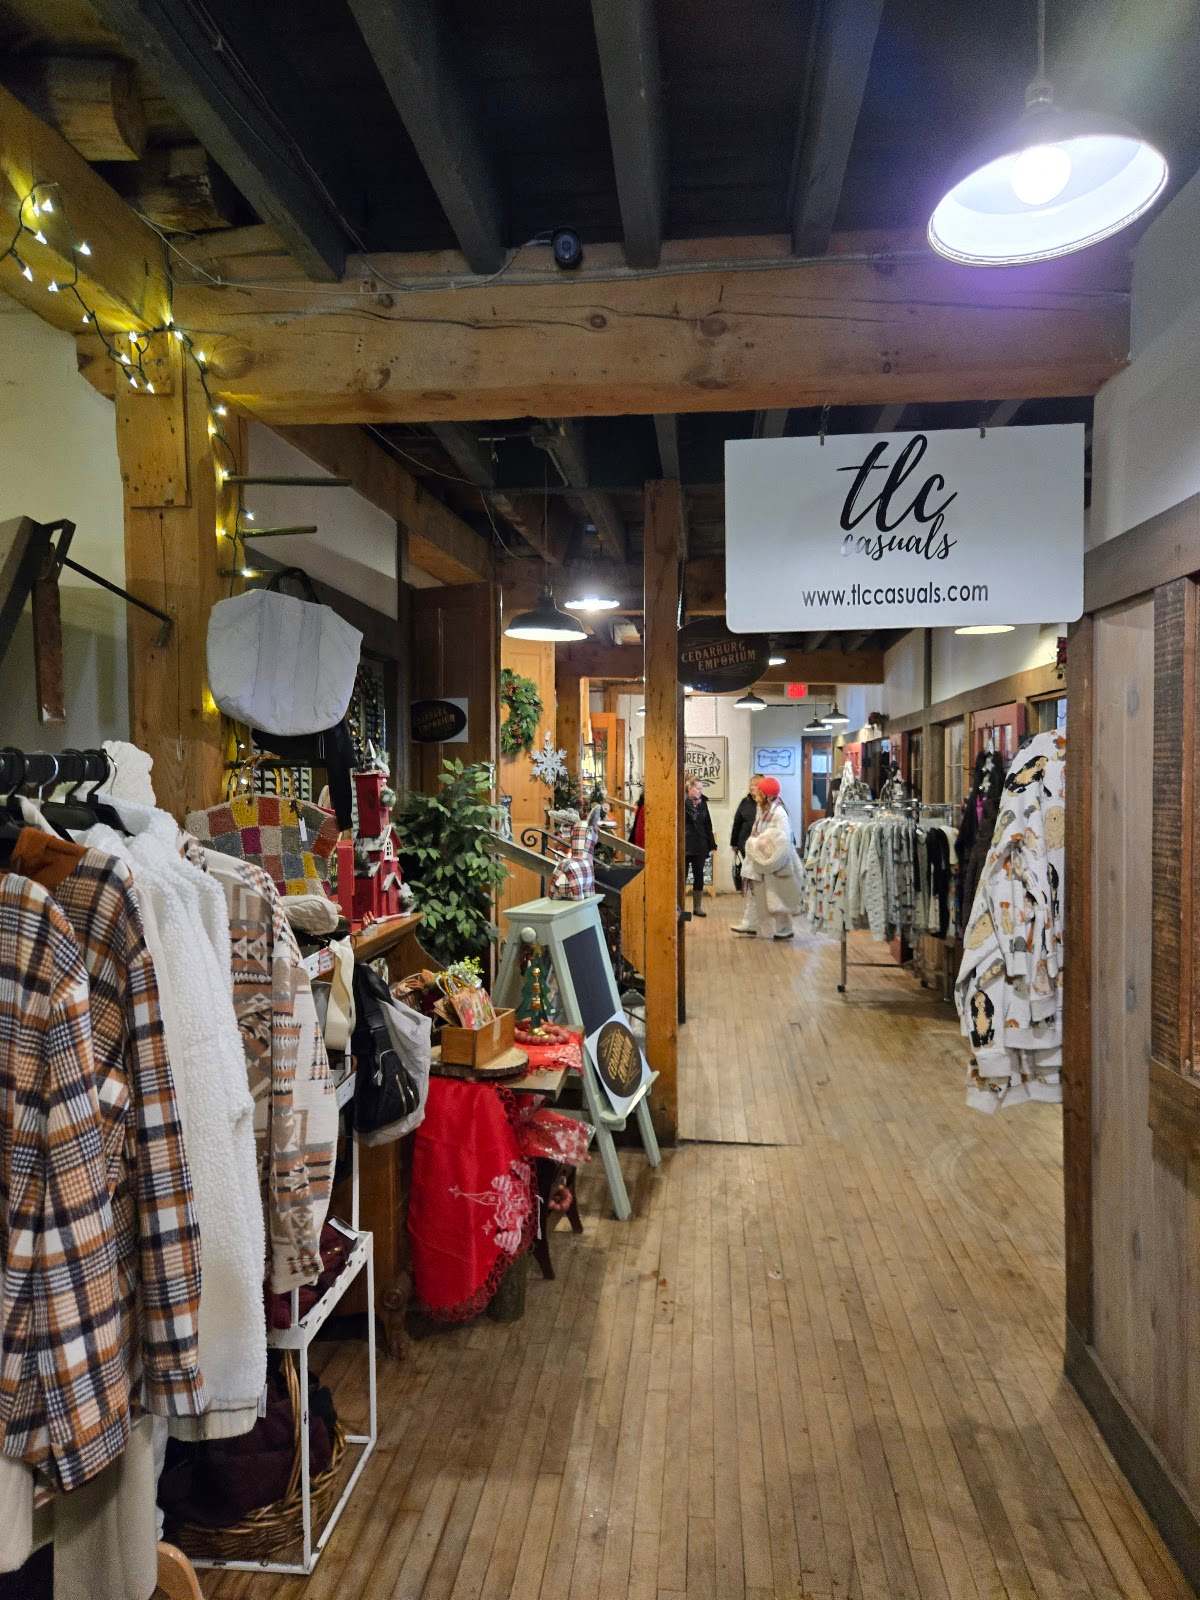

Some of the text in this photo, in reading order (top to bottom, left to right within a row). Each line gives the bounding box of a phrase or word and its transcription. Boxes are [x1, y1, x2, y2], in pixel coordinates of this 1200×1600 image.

[836, 434, 958, 532] tlc
[840, 513, 958, 561] casuals
[802, 581, 989, 608] www.tlccasuals.com
[698, 649, 756, 672] EMPORIUM
[684, 752, 708, 766] REEK
